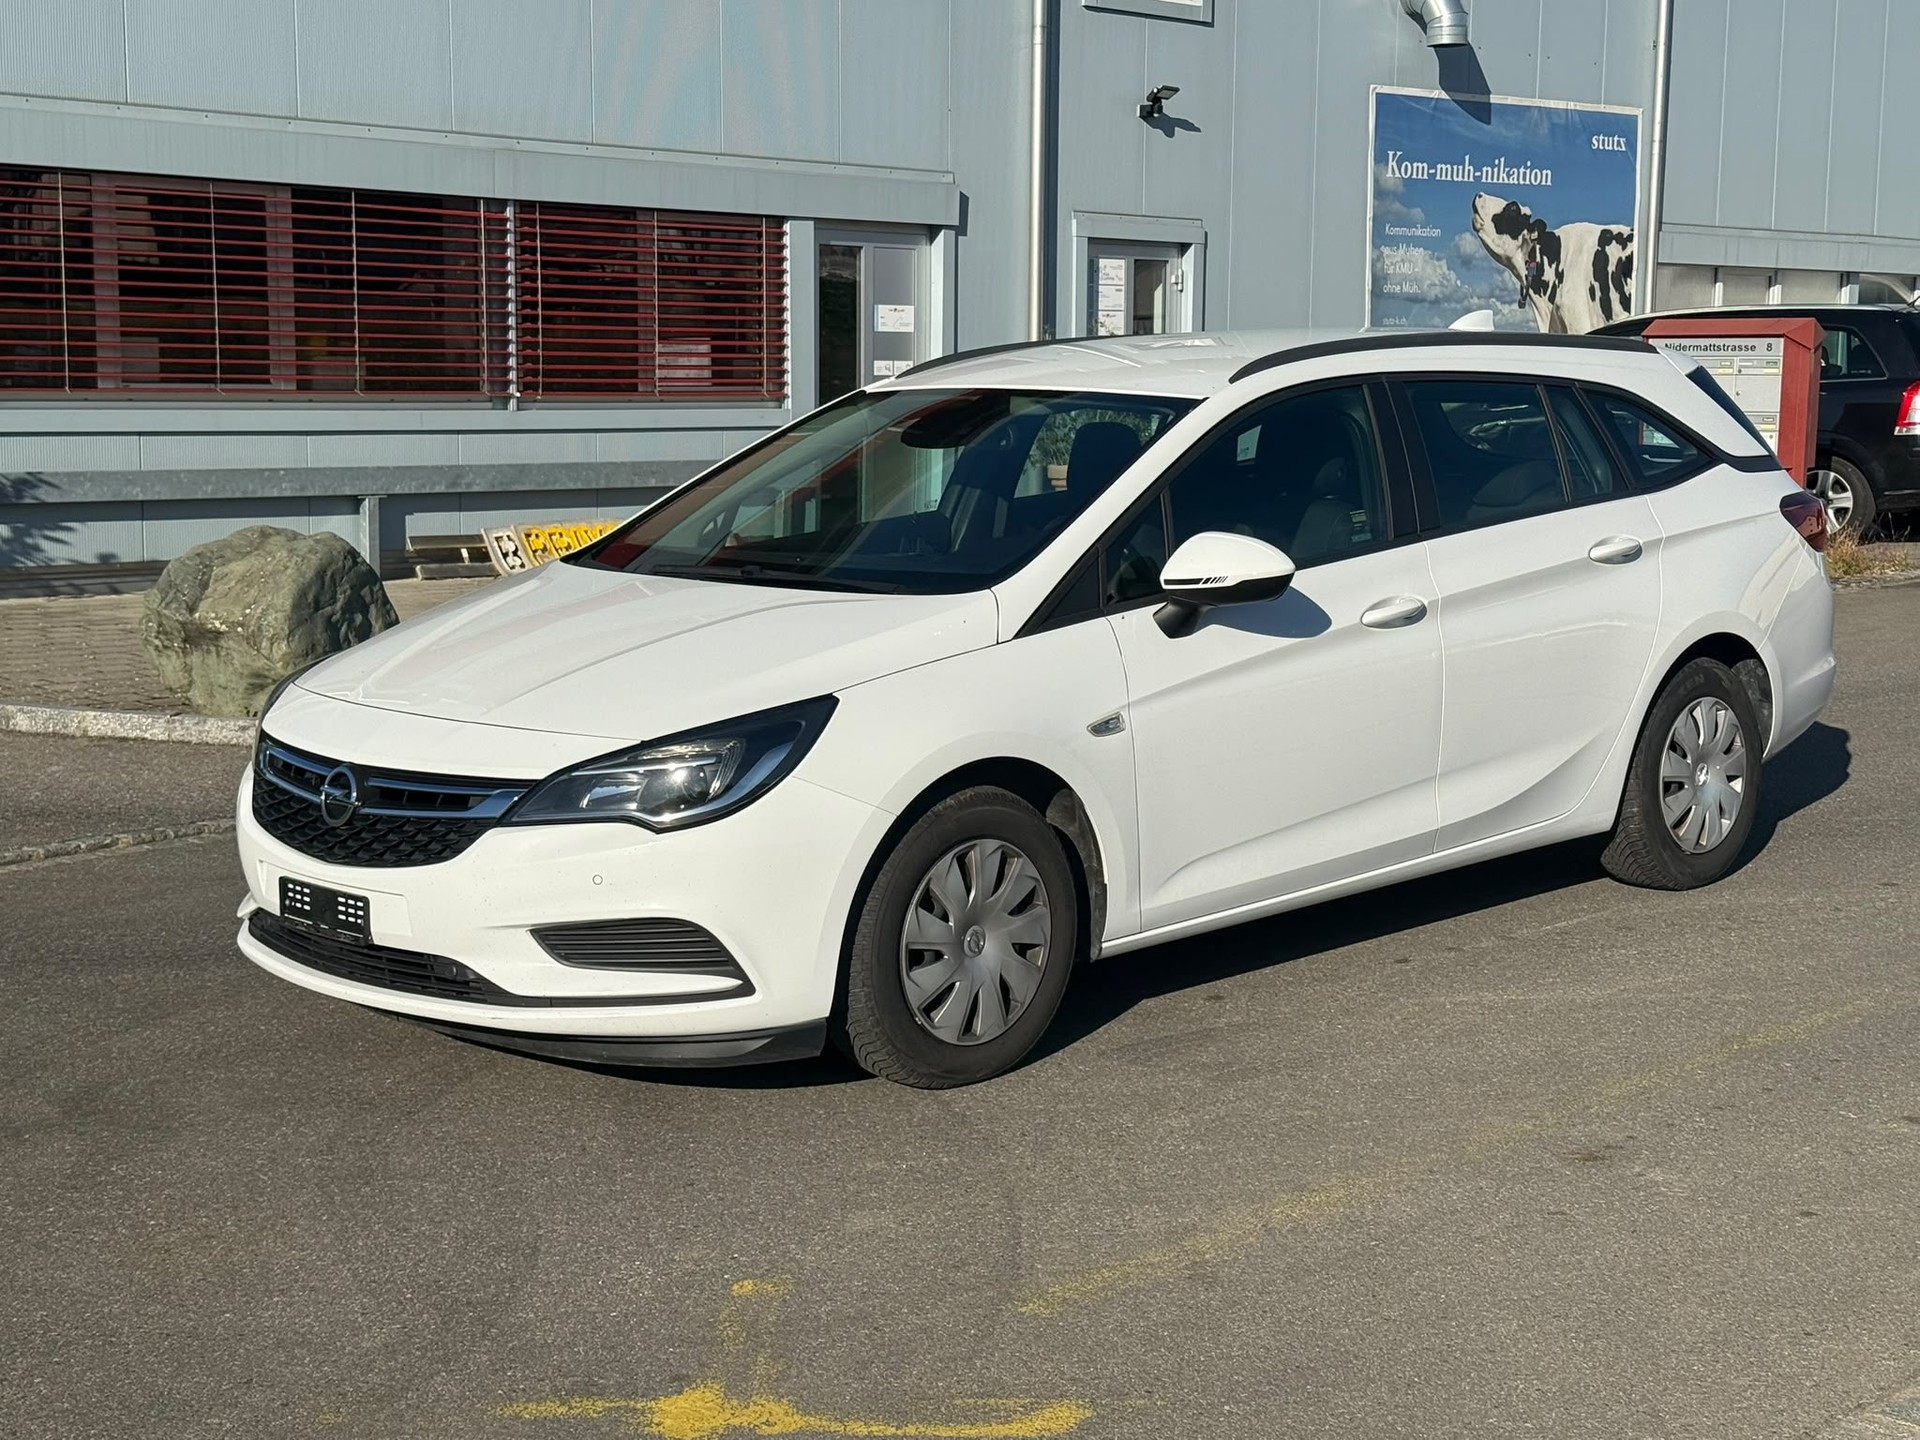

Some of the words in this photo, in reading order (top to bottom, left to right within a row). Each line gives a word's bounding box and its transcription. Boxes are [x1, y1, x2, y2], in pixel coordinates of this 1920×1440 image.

[1591, 133, 1627, 152] stutz
[1385, 150, 1553, 186] Kom-muh-nikation
[1384, 223, 1441, 237] Kommunikation
[1396, 263, 1413, 274] KMU
[1382, 281, 1401, 294] ohne
[1766, 342, 1773, 352] 8
